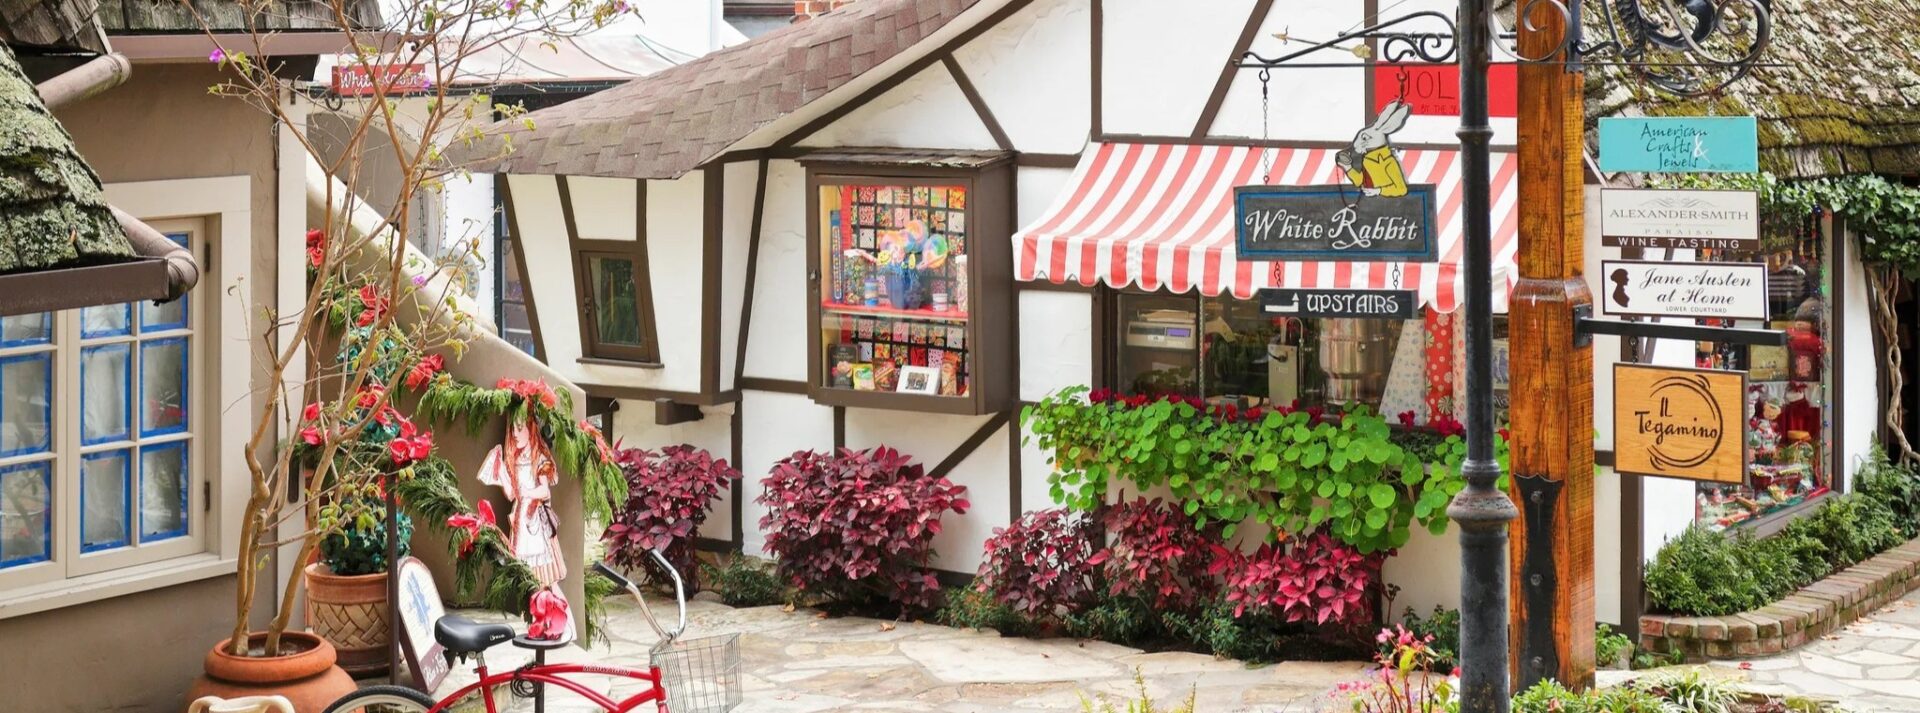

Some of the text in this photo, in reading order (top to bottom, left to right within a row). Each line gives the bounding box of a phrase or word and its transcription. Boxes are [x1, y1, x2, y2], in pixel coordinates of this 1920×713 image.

[340, 70, 374, 89] Whit
[1394, 70, 1456, 99] JOL
[1640, 122, 1709, 140] American
[1646, 133, 1710, 163] Crafts &
[1658, 151, 1699, 171] Jewels
[1244, 203, 1418, 250] White Rabbit
[1644, 228, 1713, 236] PARAISO
[1618, 236, 1740, 249] WINE TASTING
[1639, 267, 1752, 290] Jane Austen
[1306, 293, 1399, 314] UPSTAIRS
[1656, 287, 1736, 305] at Home
[1666, 305, 1727, 314] LOWER COURTYARD
[1634, 410, 1718, 445] Tegamino
